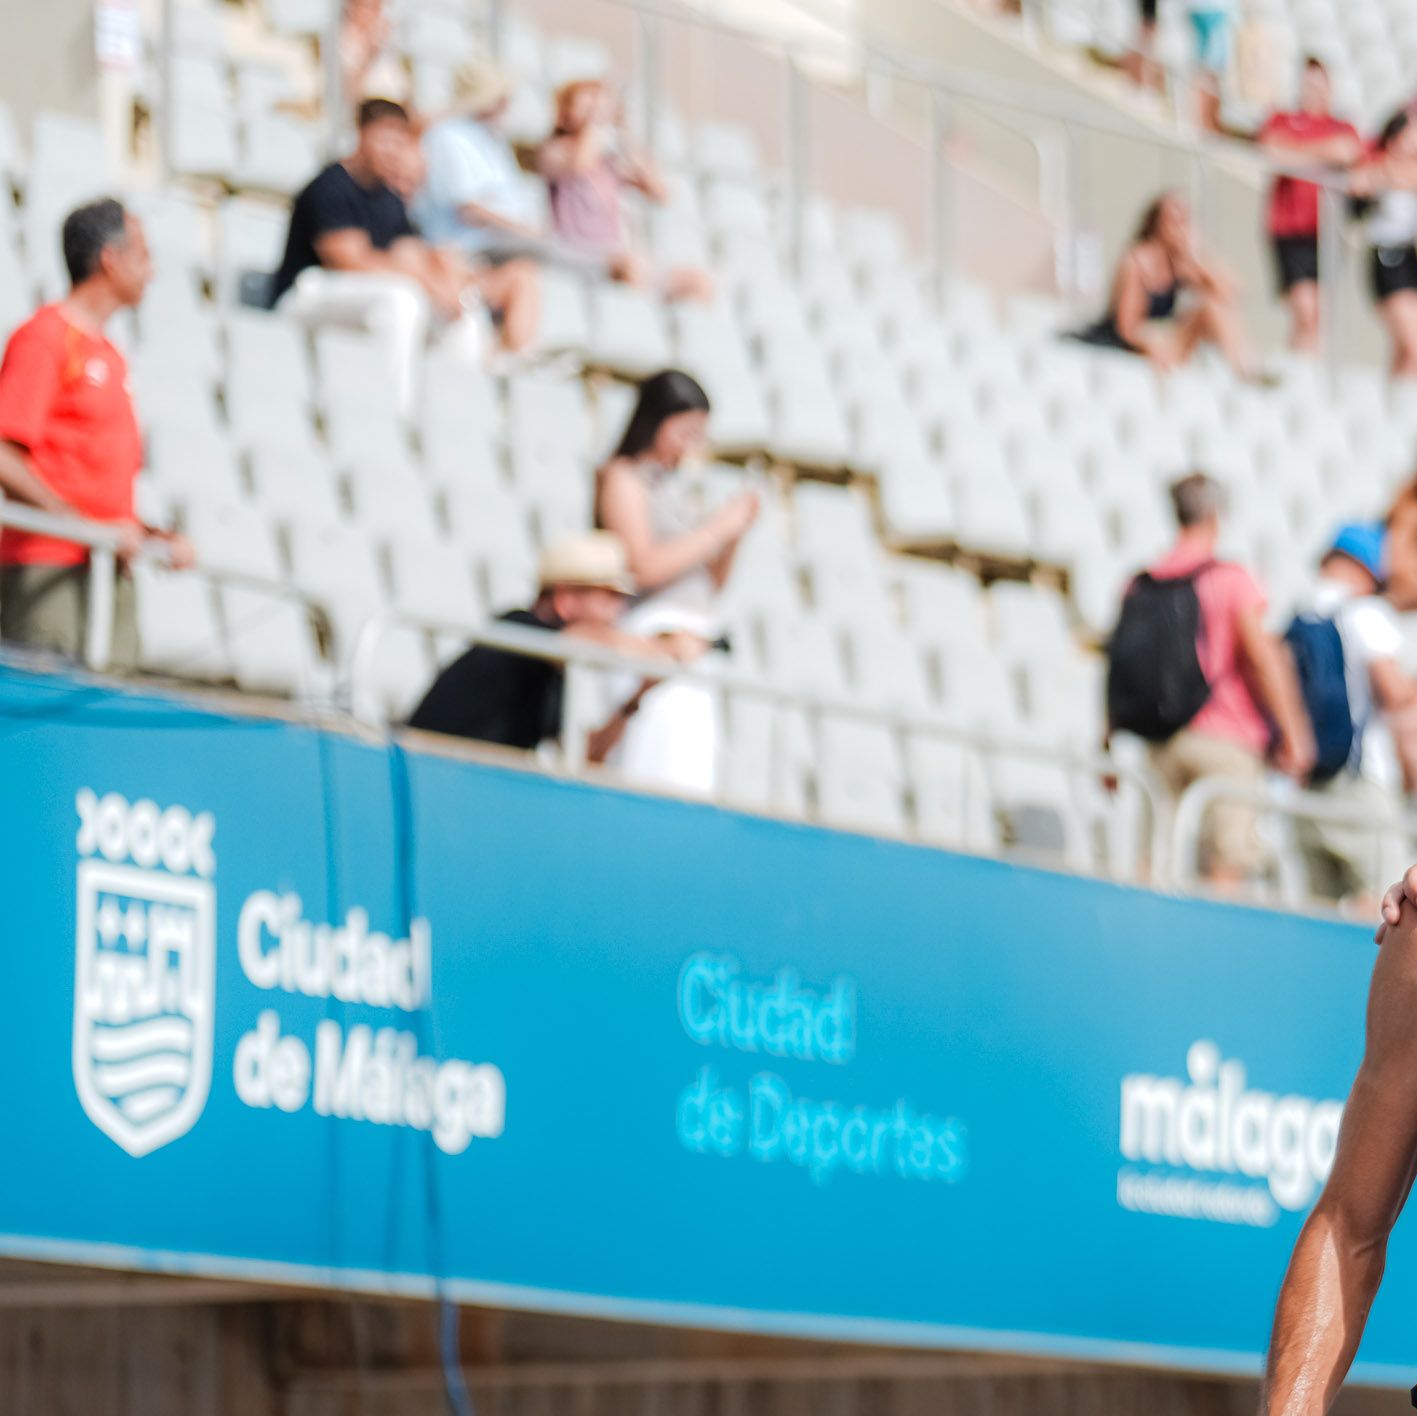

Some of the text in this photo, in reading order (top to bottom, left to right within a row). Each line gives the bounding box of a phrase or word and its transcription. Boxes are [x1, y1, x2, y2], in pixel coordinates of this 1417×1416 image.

[238, 889, 434, 1012] Ciudad
[677, 951, 858, 1063] Ciudad
[233, 1008, 507, 1155] de Málaga
[676, 1065, 970, 1185] de Deportes
